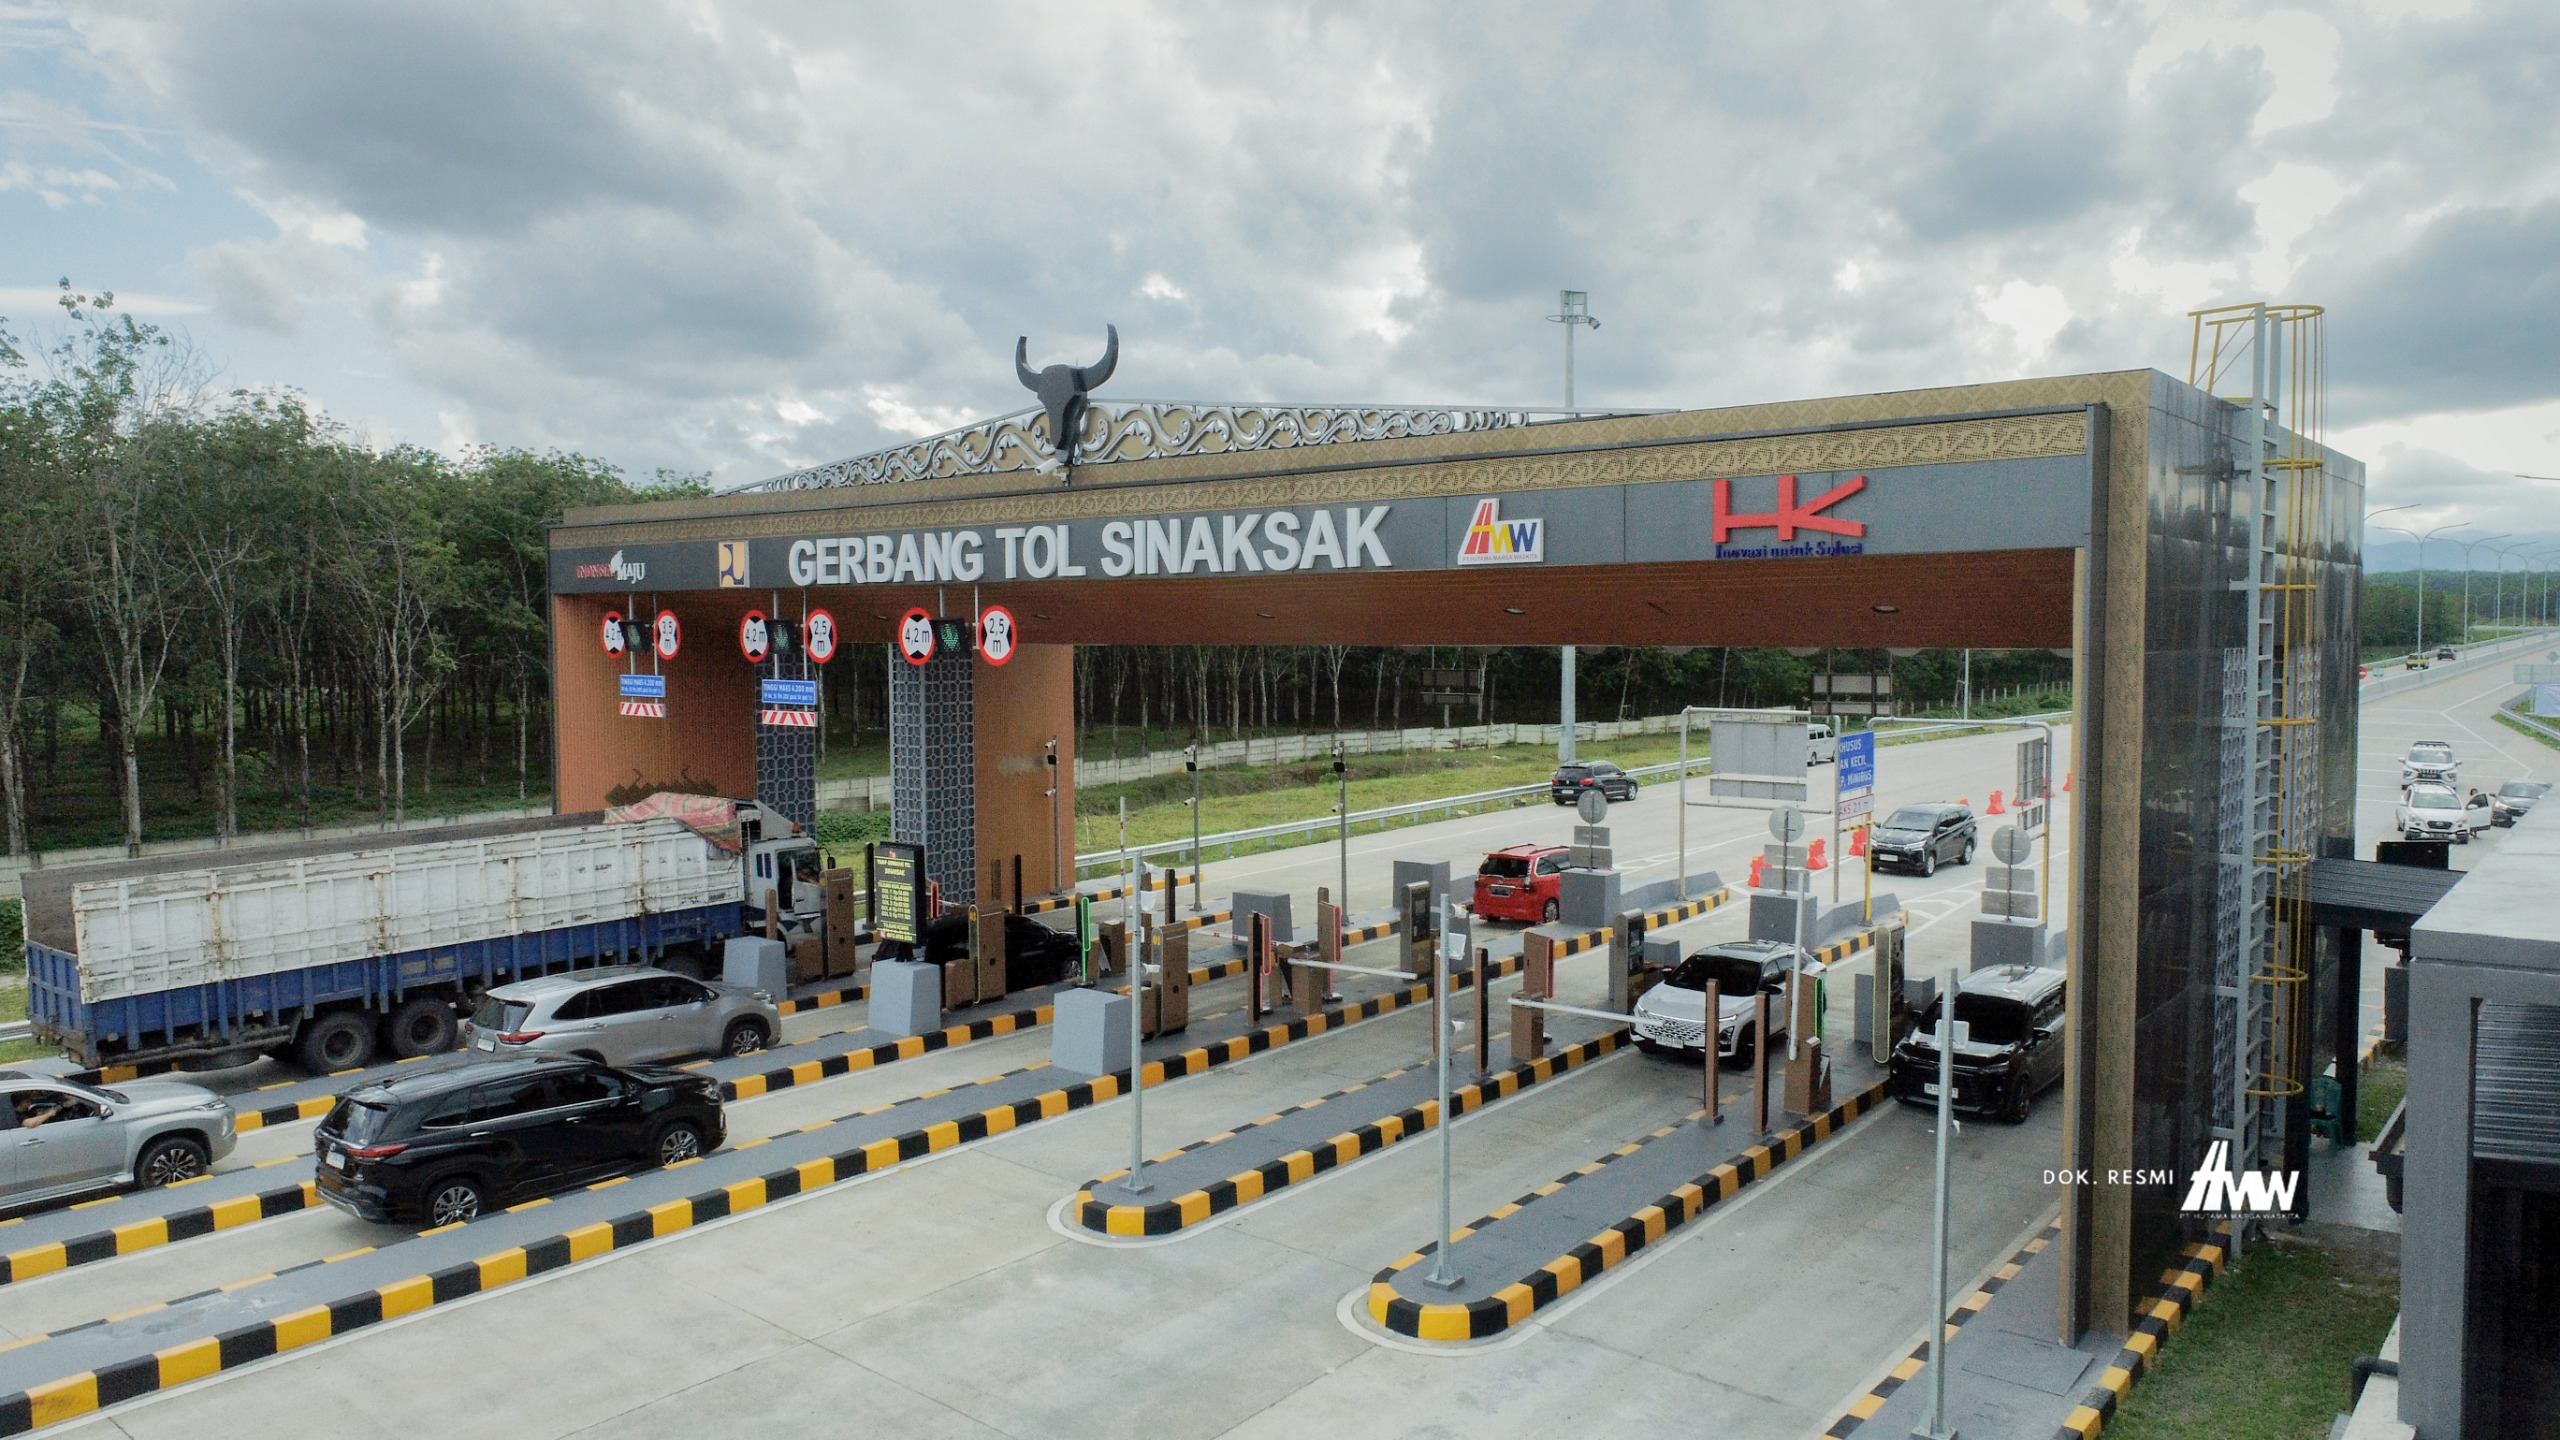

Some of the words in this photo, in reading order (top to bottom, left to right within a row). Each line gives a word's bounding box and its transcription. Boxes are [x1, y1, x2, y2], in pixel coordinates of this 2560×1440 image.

[788, 531, 983, 586] GERBANG
[995, 524, 1086, 581] TOL
[1101, 504, 1393, 577] SINAKSAK
[617, 562, 646, 584] MAJU
[813, 620, 827, 637] 2,5
[989, 618, 1005, 636] 2,5
[758, 631, 766, 643] m
[905, 627, 919, 645] 4,2
[921, 630, 930, 643] m
[817, 639, 825, 652] m
[992, 639, 1002, 653] m
[1851, 755, 1867, 768] KECIL
[1848, 770, 1872, 785] MINIBUS
